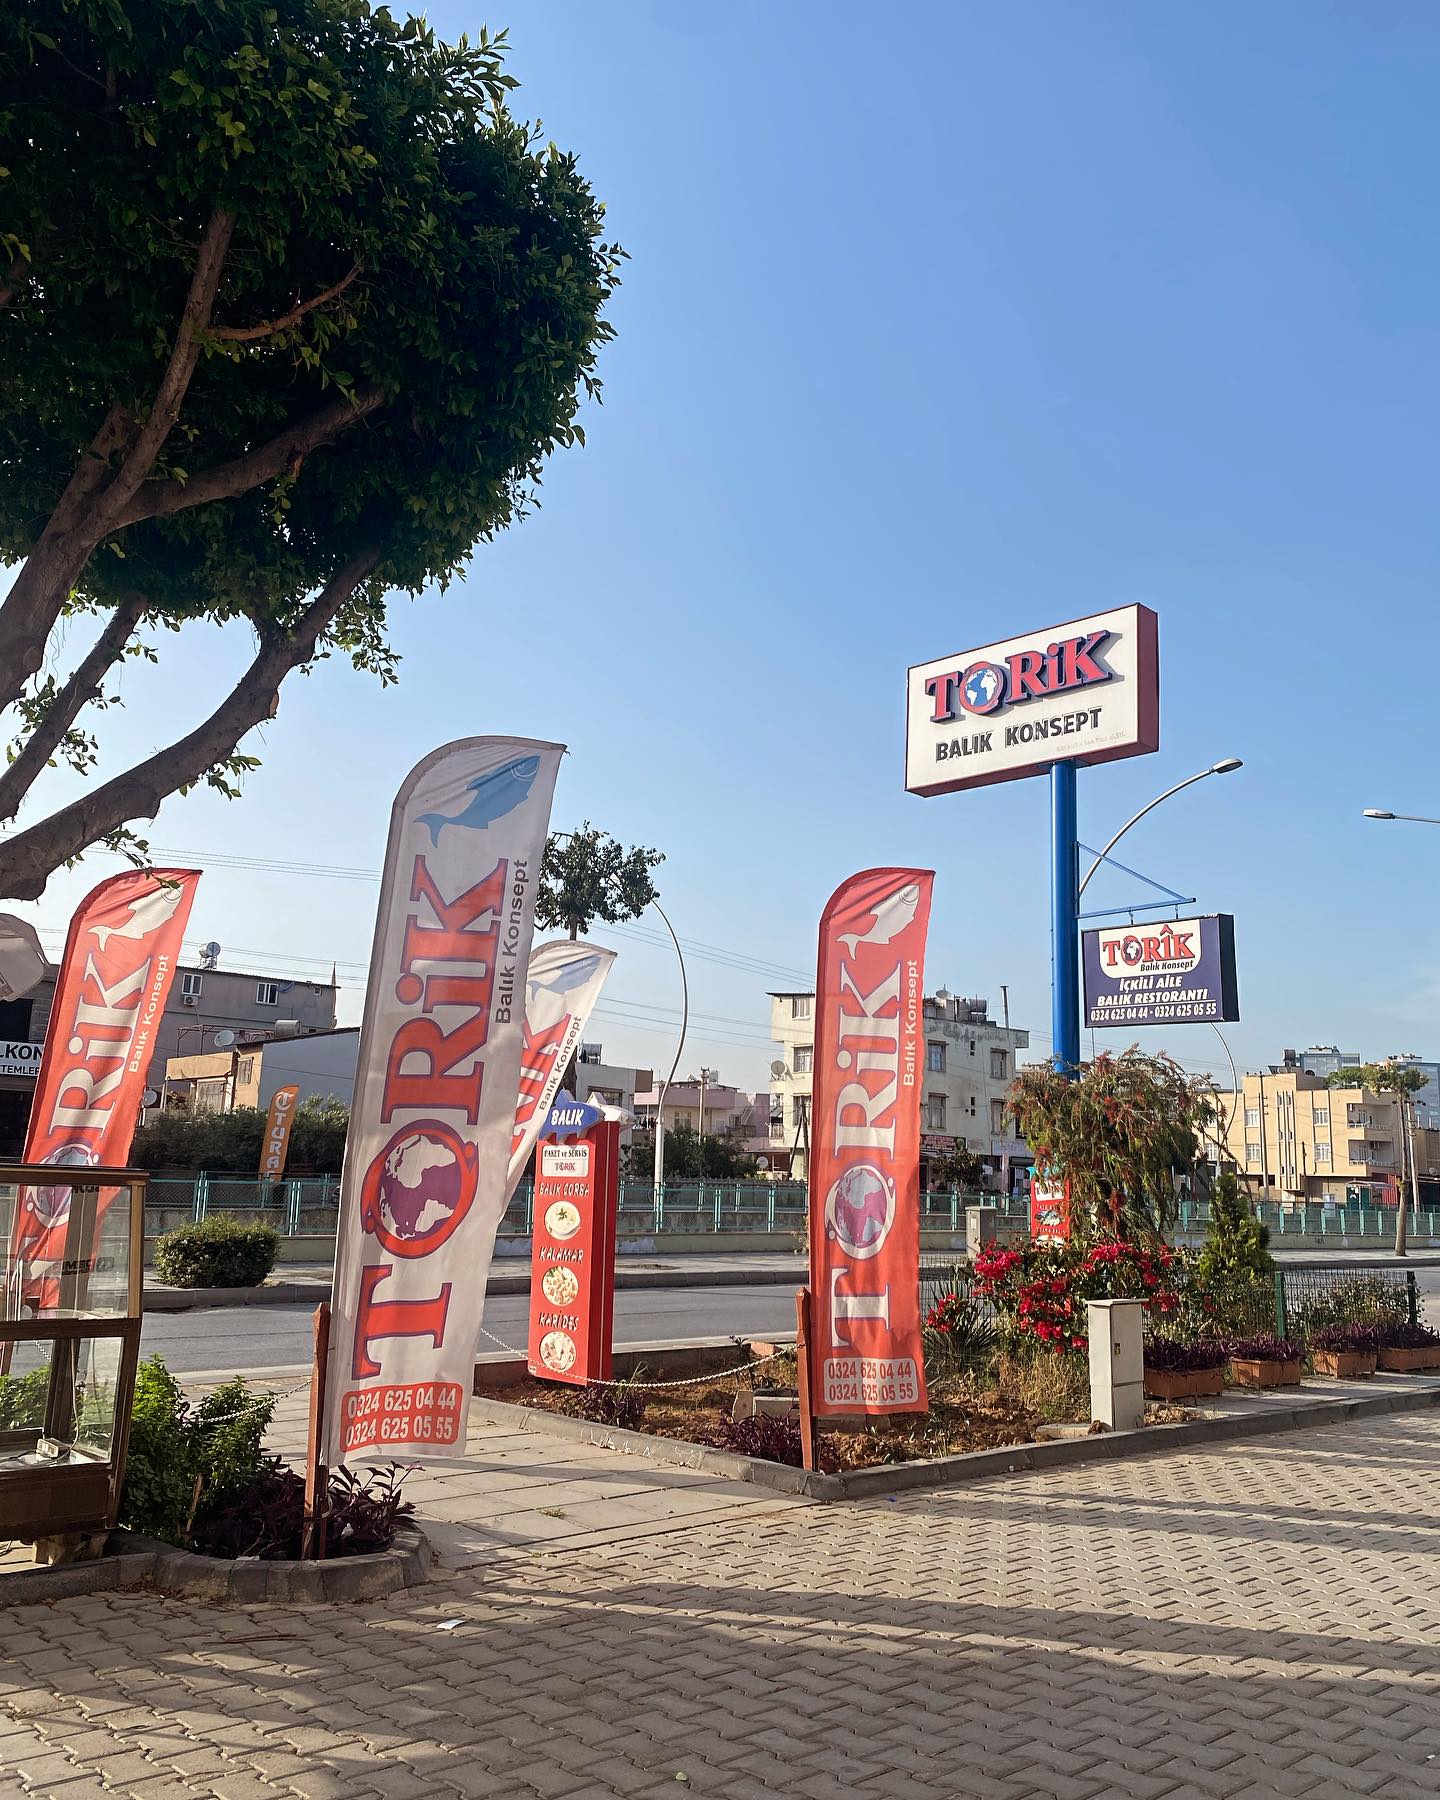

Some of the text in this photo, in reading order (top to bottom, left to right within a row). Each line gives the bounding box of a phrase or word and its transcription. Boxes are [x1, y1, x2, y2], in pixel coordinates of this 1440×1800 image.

[936, 732, 993, 761] BALIK
[1005, 707, 1102, 747] KONSEPT
[502, 860, 529, 957] Konsept
[1162, 959, 1194, 970] Konsept
[143, 954, 169, 1026] Konsept
[1119, 975, 1183, 993] İÇKİLİ AİLE
[904, 960, 919, 1033] Konsept
[1097, 989, 1208, 1007] BALIK RESTORANTI
[1091, 1009, 1110, 1021] 0324
[1111, 1008, 1126, 1020] 625
[1127, 1007, 1137, 1019] 04
[1138, 1007, 1148, 1019] 44
[1154, 1005, 1175, 1018] 0324
[1176, 1004, 1192, 1017] 625
[1193, 1003, 1204, 1016] 05
[1206, 1002, 1217, 1015] 55
[0, 1044, 43, 1060] KON
[556, 1016, 582, 1072] Konsept
[551, 1108, 585, 1126] BALIK
[544, 1149, 560, 1158] PAKET
[568, 1148, 587, 1158] SERVİS
[539, 1183, 561, 1196] BALIK
[539, 1246, 584, 1263] KALAMAR
[538, 1310, 580, 1331] KARİDES
[829, 1361, 911, 1379] 0324 625 04 44
[829, 1383, 914, 1401] 0324 625 05 55
[347, 1387, 456, 1418] 0324 625 04 44
[345, 1415, 453, 1447] 0324 625 05 55
